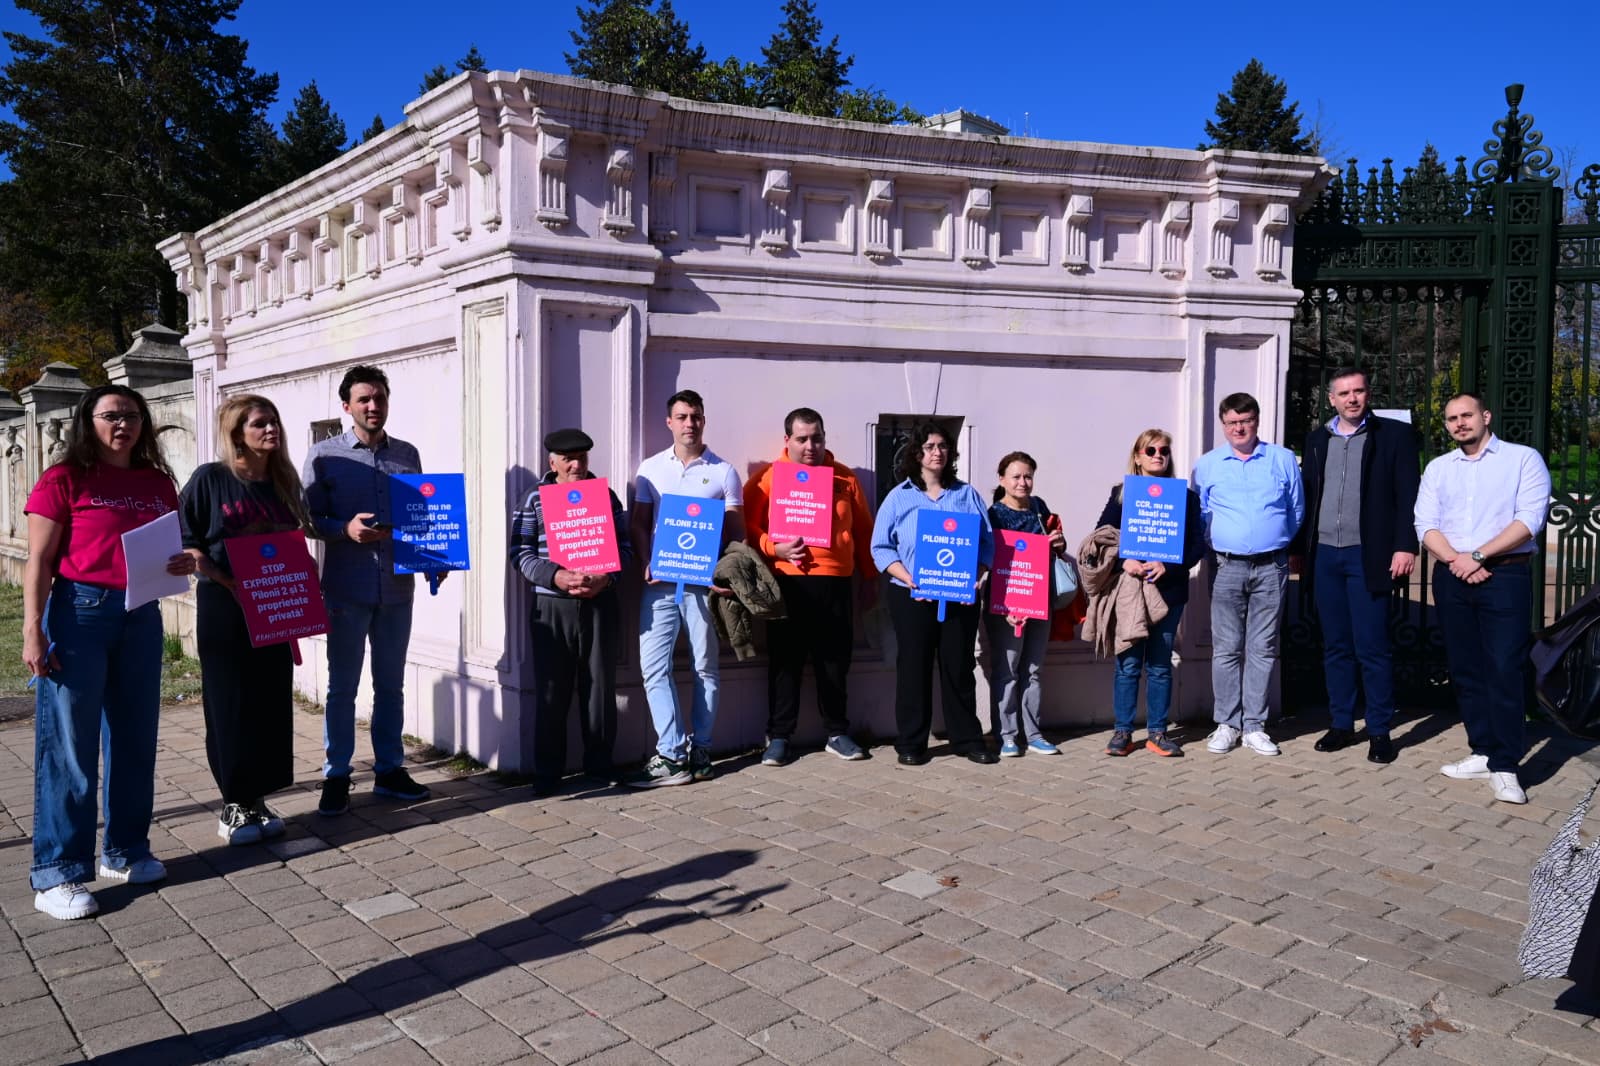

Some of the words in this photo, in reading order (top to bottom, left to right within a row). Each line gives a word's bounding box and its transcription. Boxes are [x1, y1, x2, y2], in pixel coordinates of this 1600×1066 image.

[90, 495, 145, 511] declic
[407, 504, 426, 512] CCR,
[776, 499, 826, 509] colectivizarea
[1136, 500, 1152, 509] CCR,
[567, 508, 587, 517] STOP
[401, 522, 427, 532] pensii
[429, 522, 459, 532] private
[550, 515, 606, 530] EXPROPRIERII!
[664, 518, 691, 528] PILONII
[1152, 519, 1178, 528] private
[402, 534, 413, 542] de
[449, 531, 459, 539] lei
[556, 530, 580, 540] Pilonii
[923, 534, 948, 544] PILONII
[427, 542, 448, 550] lună!
[560, 538, 604, 552] proprietate
[659, 550, 681, 558] Acces
[683, 552, 711, 562] interzis
[261, 563, 285, 574] STOP
[658, 560, 708, 571] politicienilor!
[919, 568, 941, 576] Acces
[943, 570, 970, 579] interzis
[997, 569, 1043, 580] colectivizarea
[243, 571, 308, 589] EXPROPRIERII!
[920, 577, 968, 588] politicienilor!
[1006, 579, 1034, 587] pensiilor
[252, 588, 280, 600] Pilonii
[1006, 587, 1032, 596] private!
[257, 597, 309, 614] proprietate
[268, 608, 304, 624] privată!
